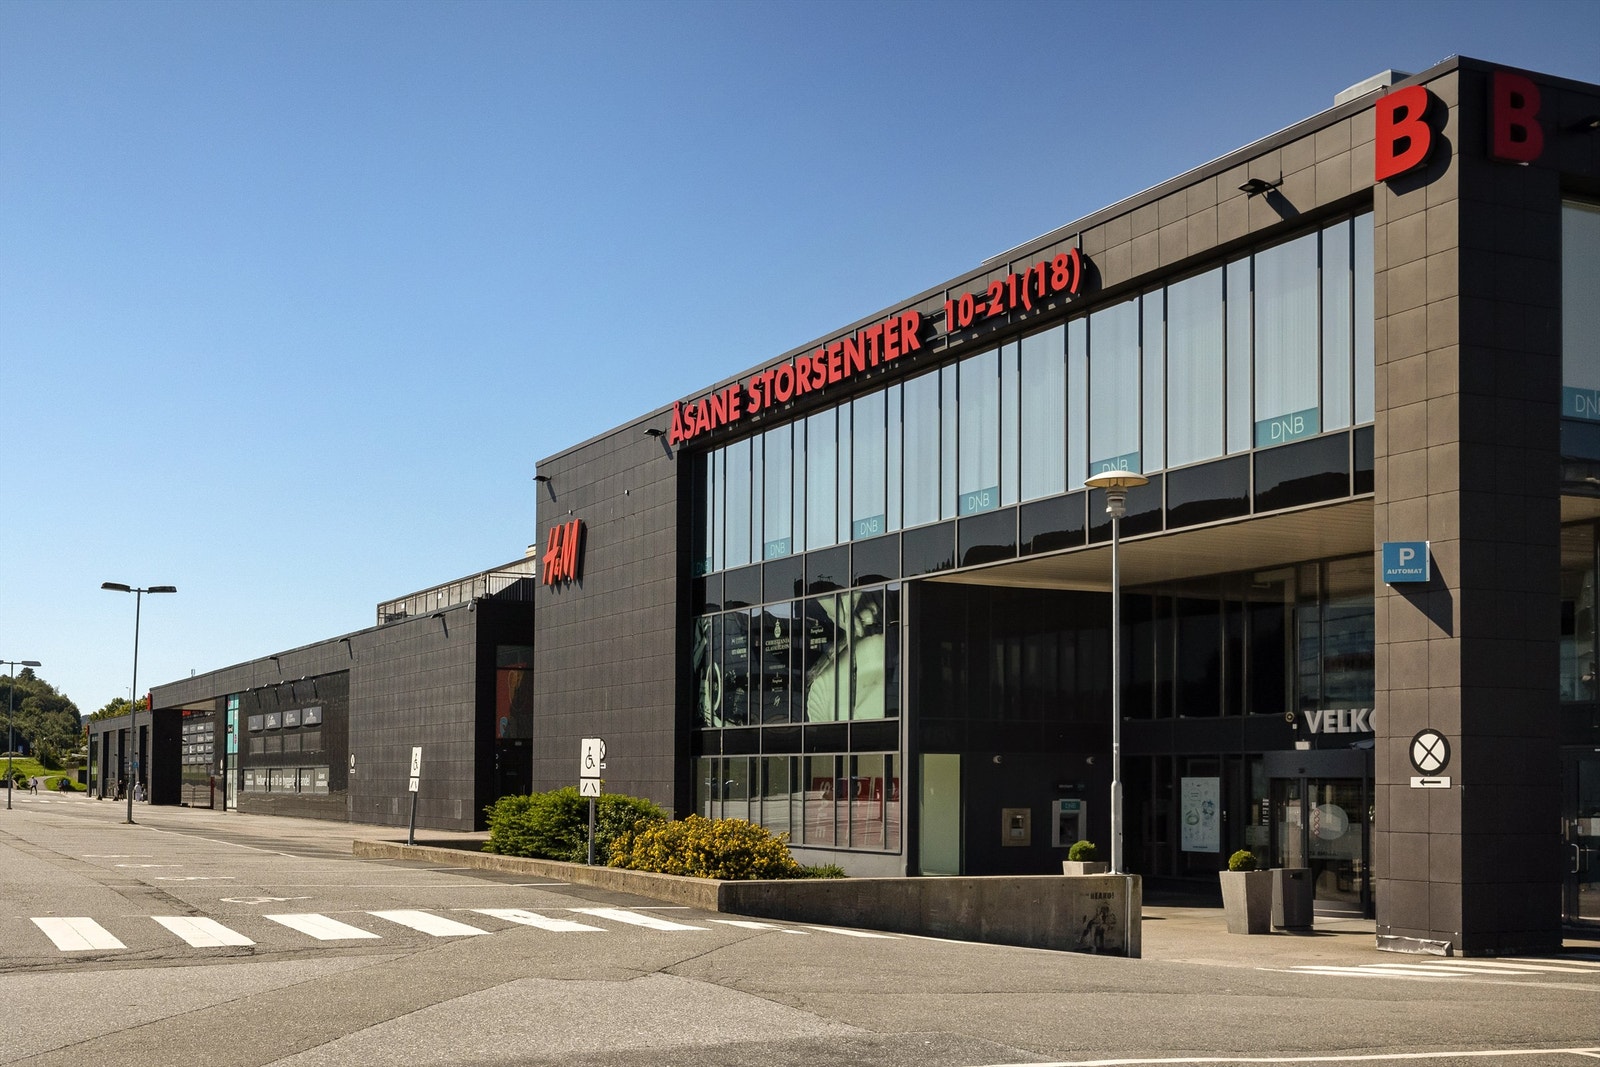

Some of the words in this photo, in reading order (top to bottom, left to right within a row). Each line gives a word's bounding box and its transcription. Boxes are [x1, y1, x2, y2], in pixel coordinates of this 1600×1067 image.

[1493, 70, 1544, 163] B
[1375, 84, 1431, 182] B
[670, 384, 741, 445] ÅSANE
[747, 310, 922, 415] STORSENTER
[943, 247, 1082, 333] 10-21(18)
[1575, 392, 1600, 419] DN
[1272, 412, 1304, 442] DNB
[968, 489, 990, 513] DNB
[860, 517, 879, 537] DNB
[542, 517, 581, 585] H&M
[770, 541, 786, 558] DNB
[1399, 547, 1415, 566] P
